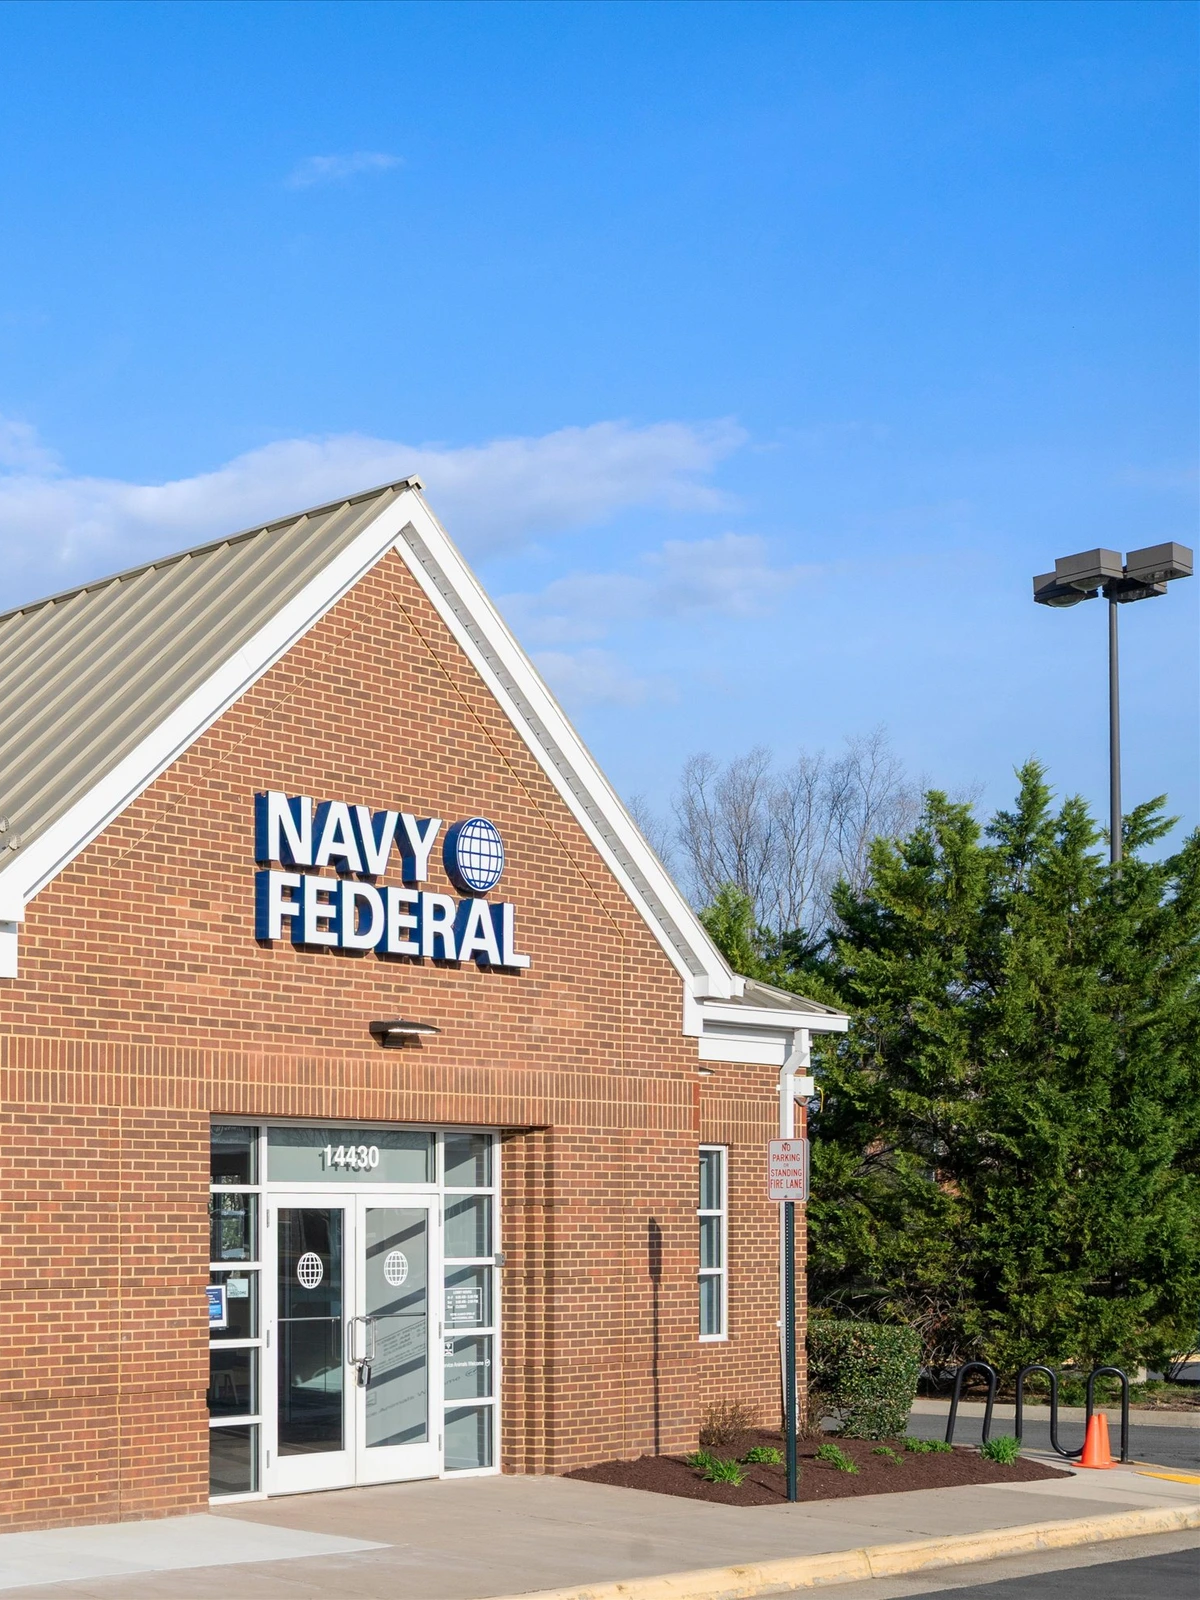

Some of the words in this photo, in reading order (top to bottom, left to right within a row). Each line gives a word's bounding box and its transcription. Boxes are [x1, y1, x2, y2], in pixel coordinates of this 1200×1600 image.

[266, 790, 443, 882] NAVY
[268, 870, 530, 967] FEDERAL
[323, 1144, 380, 1168] 14430
[770, 1169, 802, 1177] STANDING
[770, 1179, 784, 1189] FIRE
[786, 1179, 802, 1188] LANE
